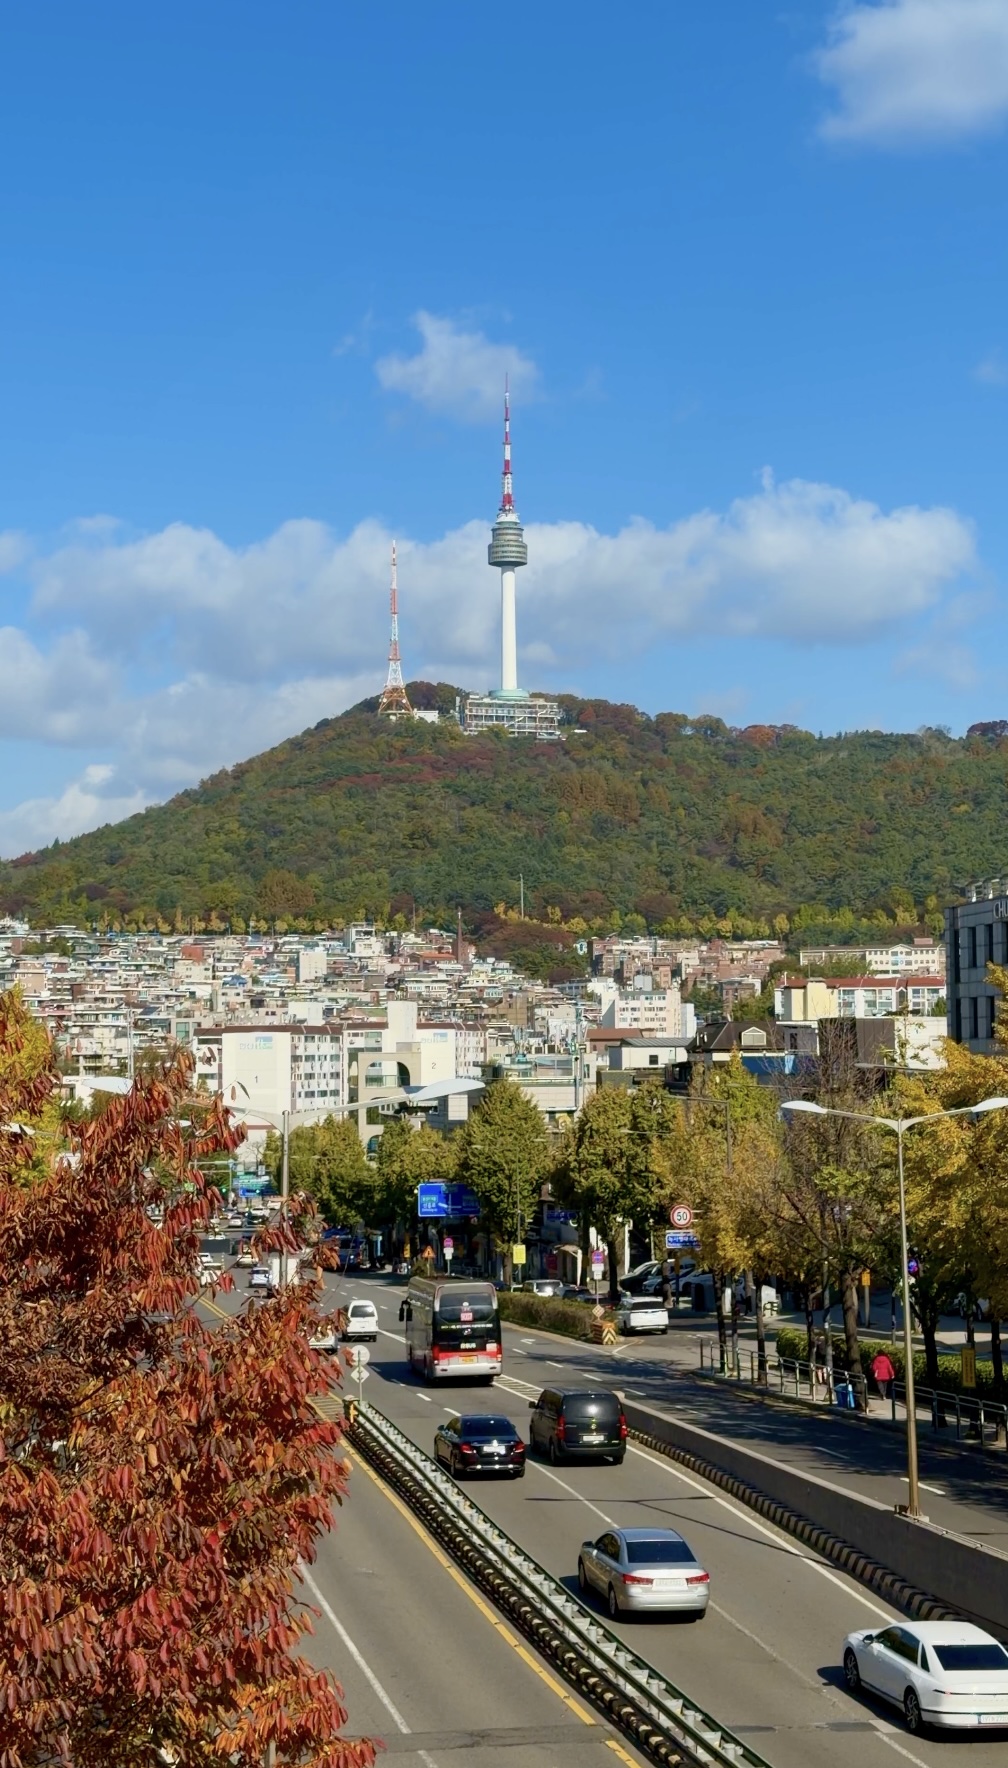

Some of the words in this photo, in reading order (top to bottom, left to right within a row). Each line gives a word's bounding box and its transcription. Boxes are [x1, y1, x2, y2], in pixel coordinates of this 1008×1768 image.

[431, 1062, 437, 1070] 2
[254, 1075, 259, 1084] 1
[676, 1211, 688, 1221] 50
